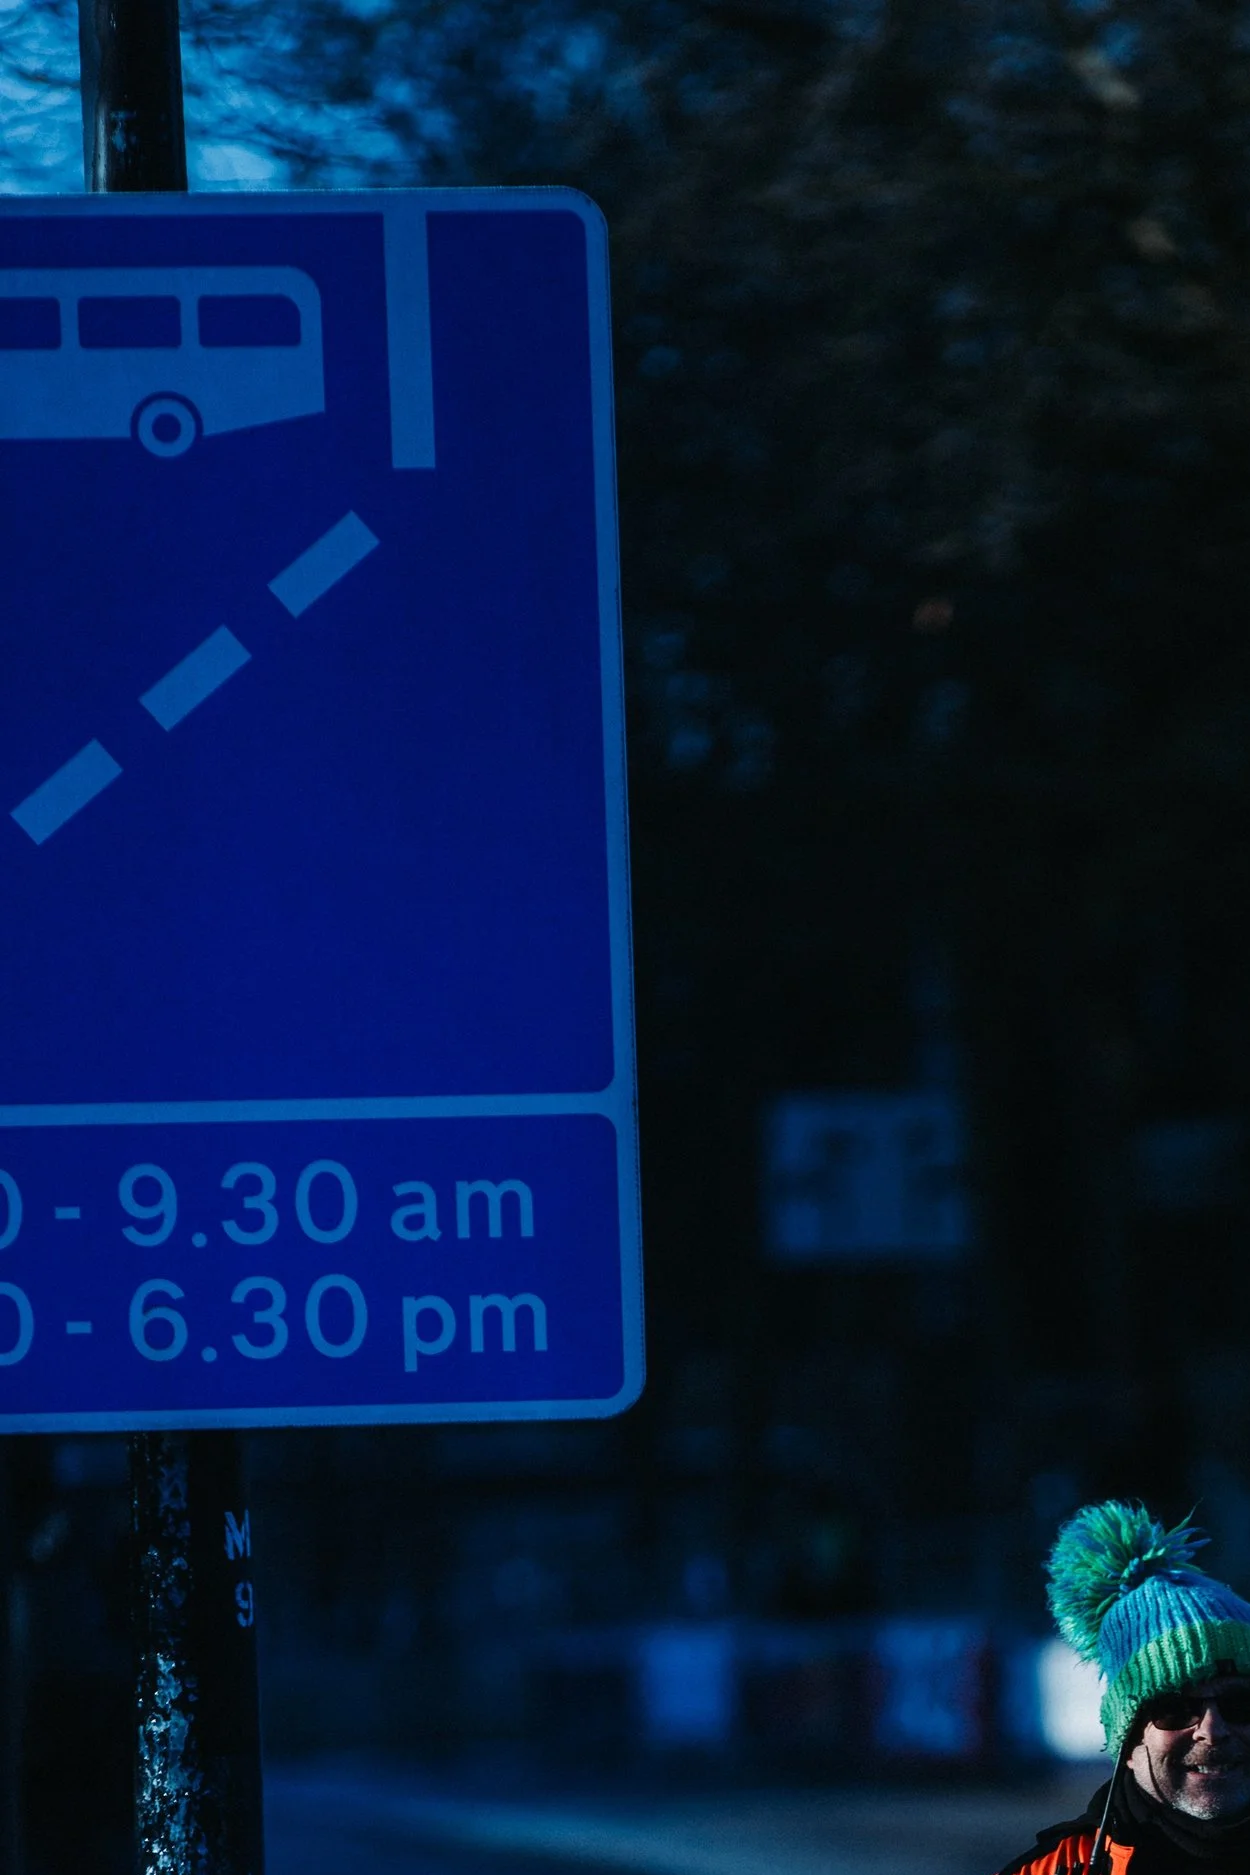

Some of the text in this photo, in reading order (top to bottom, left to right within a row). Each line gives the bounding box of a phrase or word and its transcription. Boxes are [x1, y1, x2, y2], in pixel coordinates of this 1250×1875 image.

[118, 1160, 359, 1248] 9.30
[391, 1178, 535, 1242] am
[129, 1273, 369, 1362] 6.30
[402, 1292, 549, 1372] pm
